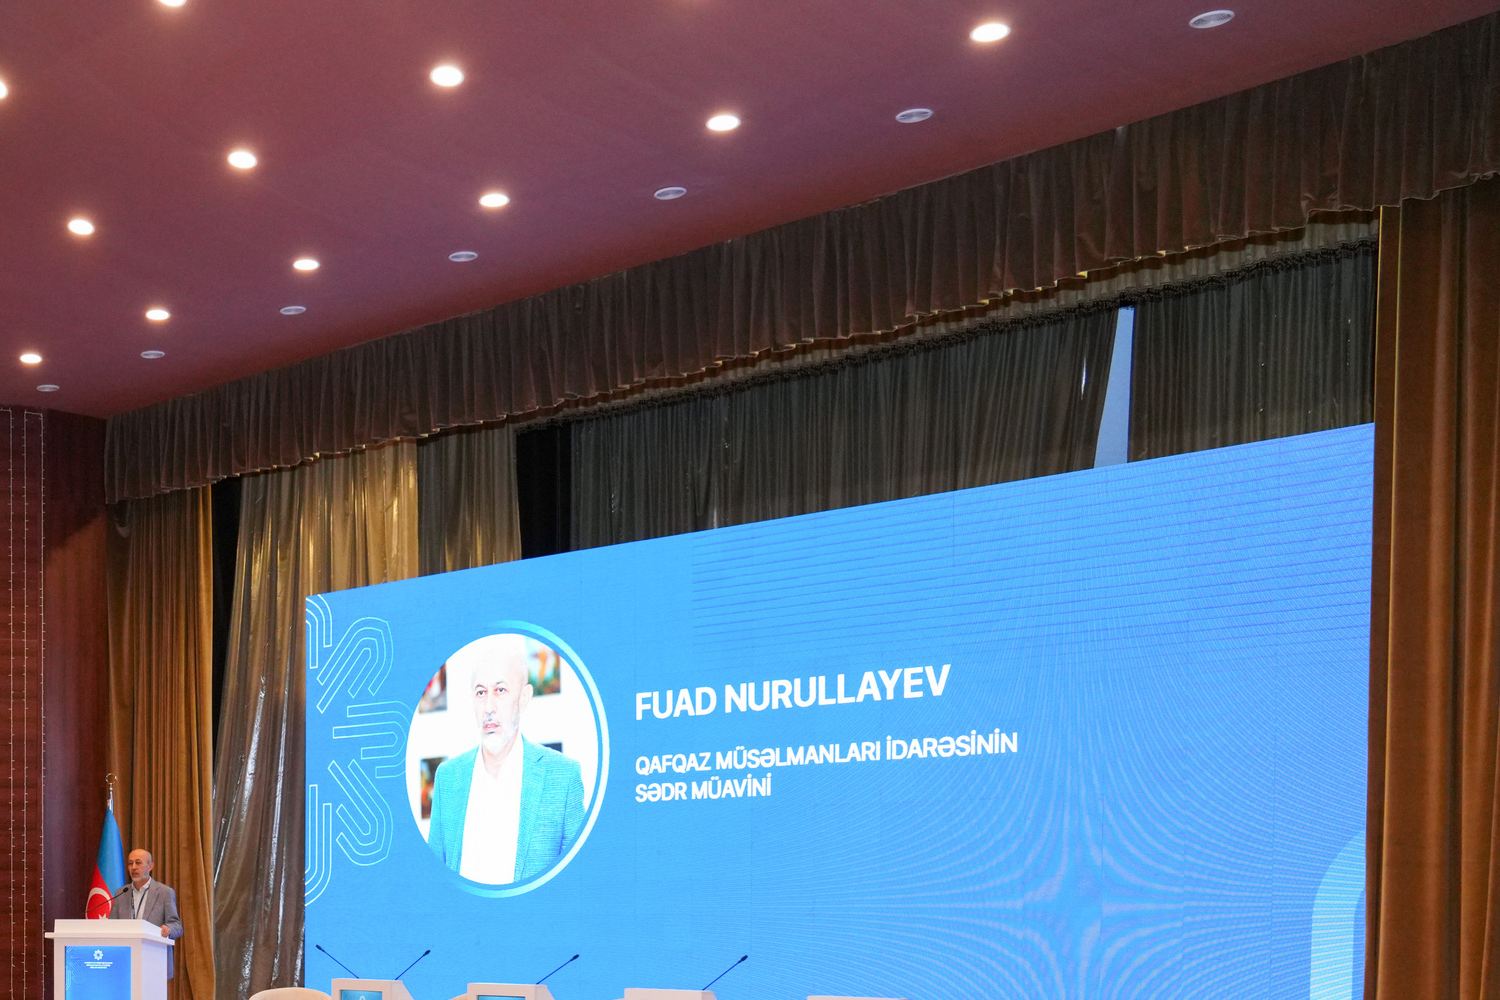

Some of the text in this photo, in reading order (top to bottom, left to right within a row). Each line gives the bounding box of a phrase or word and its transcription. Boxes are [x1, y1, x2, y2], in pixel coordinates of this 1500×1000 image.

[635, 664, 951, 720] FUAD NURULLAYEV
[635, 728, 1018, 776] QAFQAZ MÜSƏLMANLARI İDARƏSİNİN
[635, 772, 772, 803] SƏDR MÜAVİNİ
